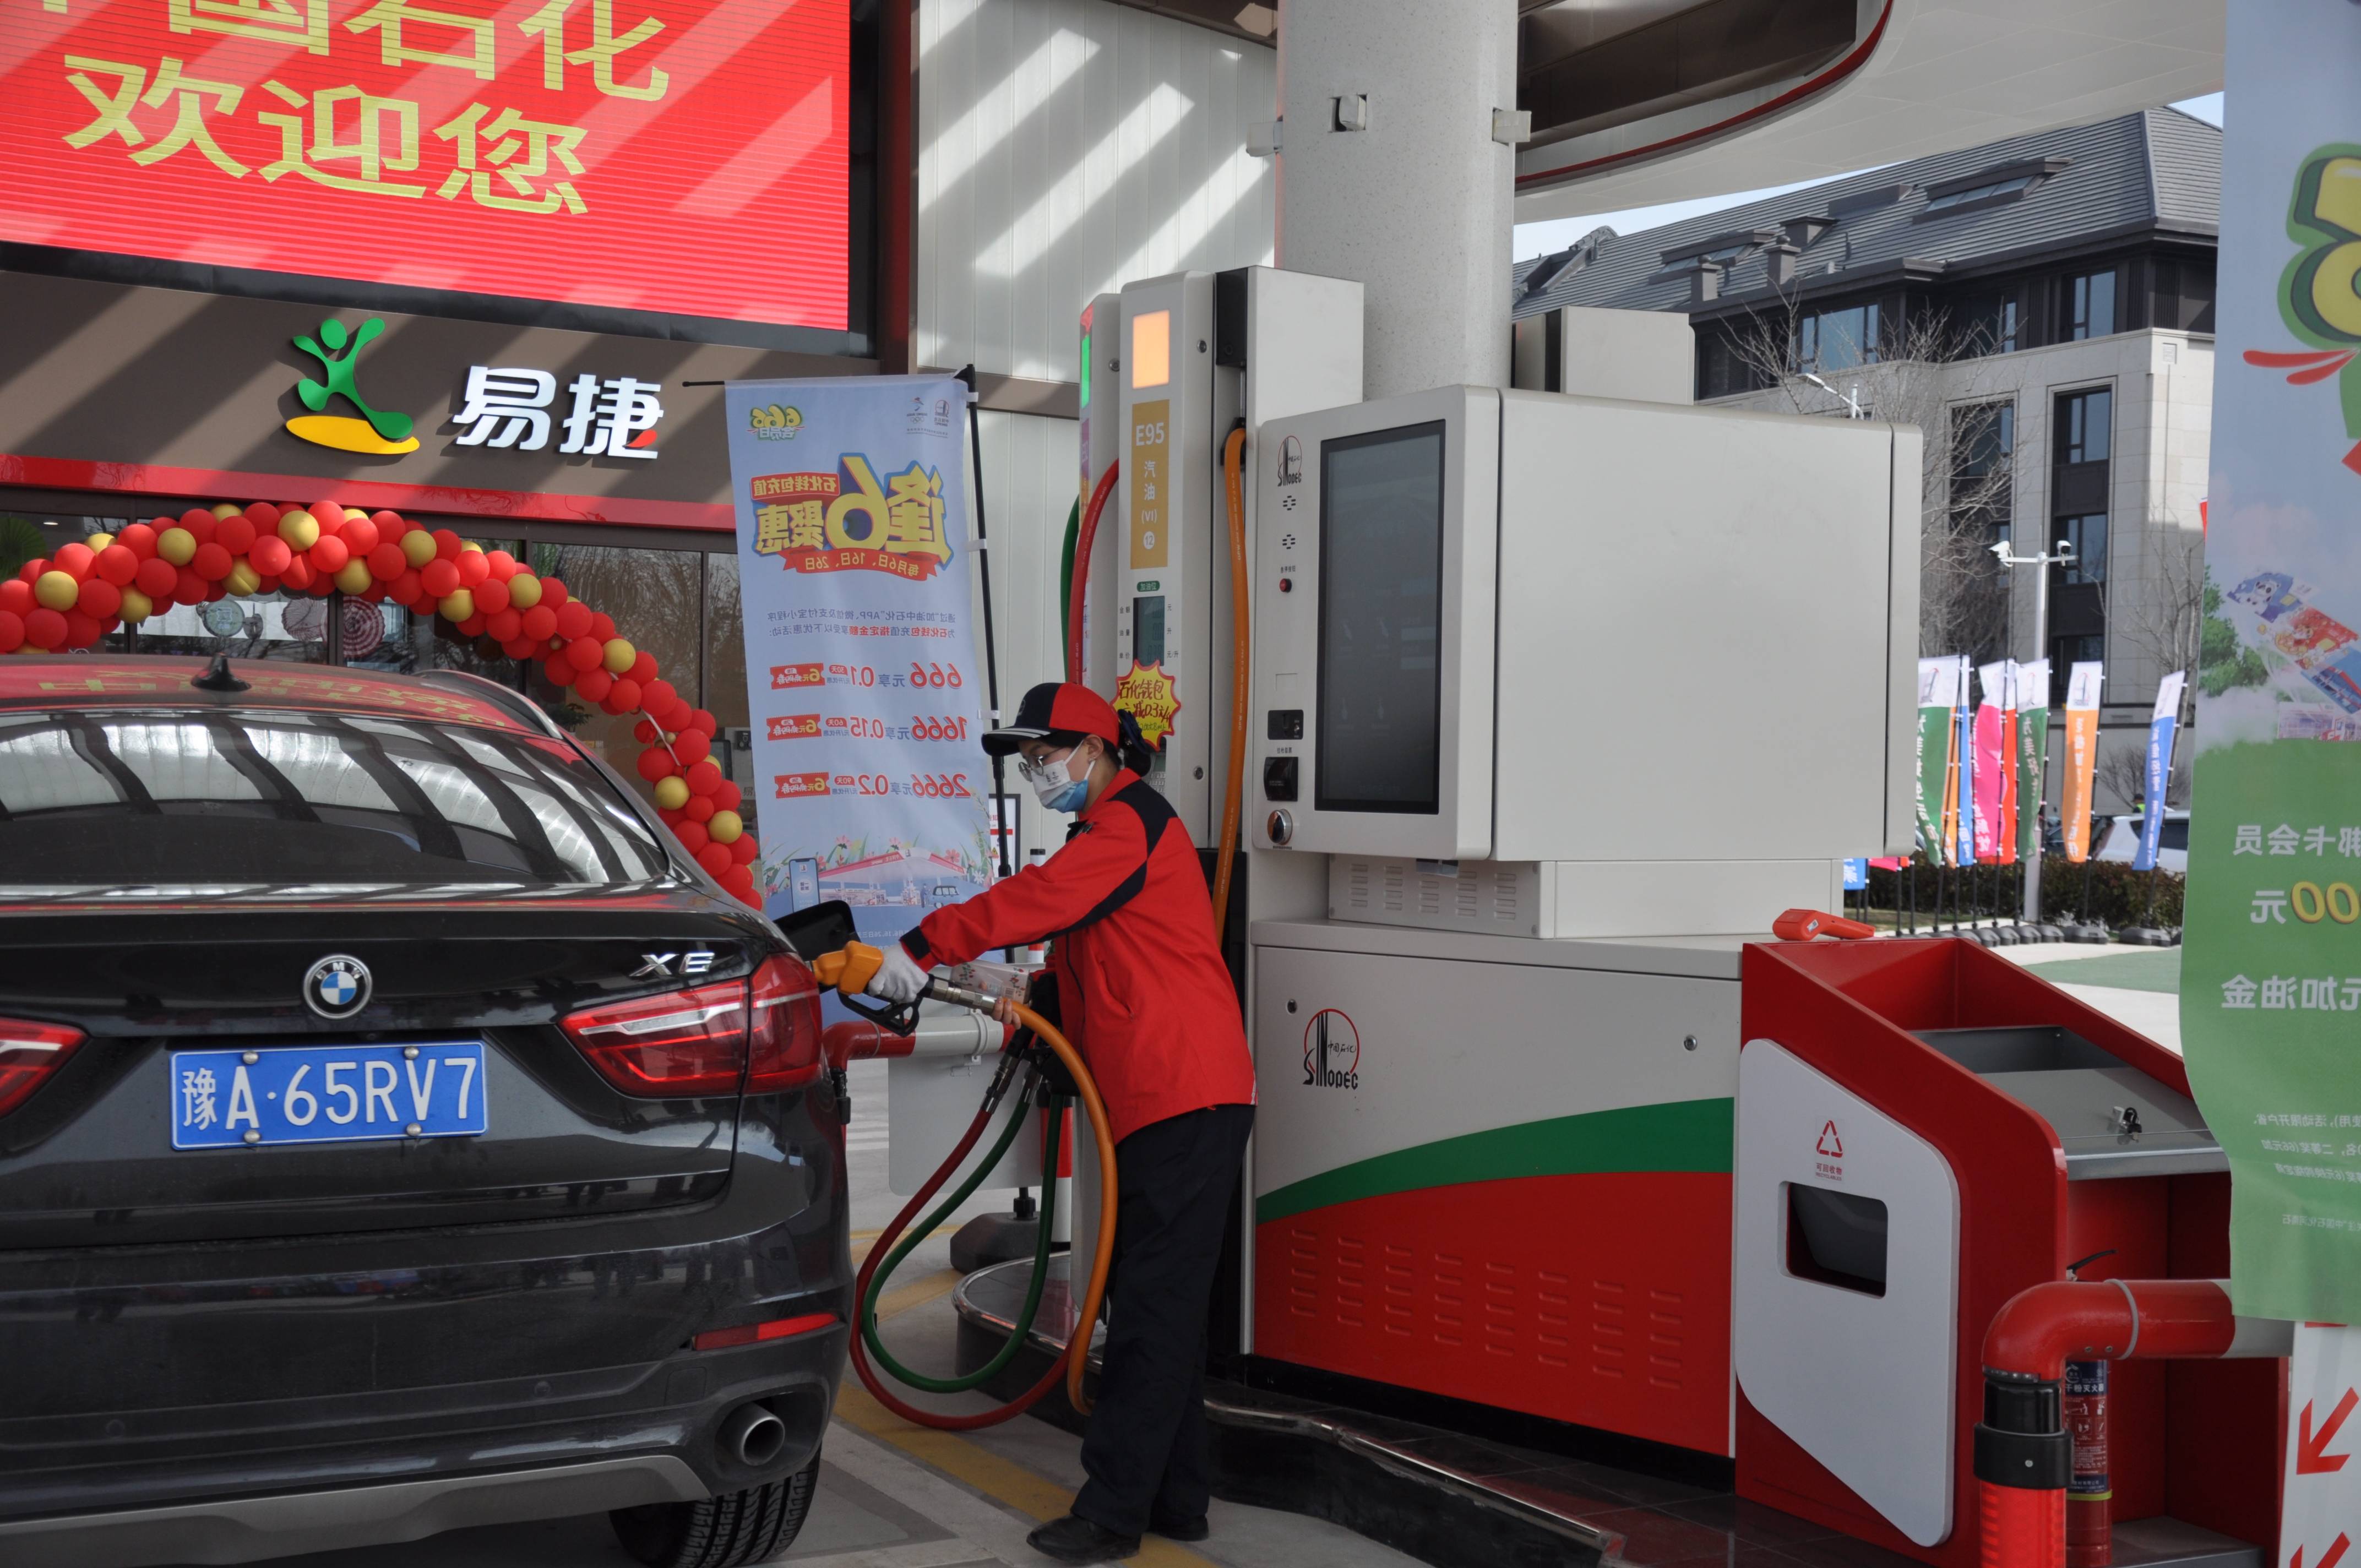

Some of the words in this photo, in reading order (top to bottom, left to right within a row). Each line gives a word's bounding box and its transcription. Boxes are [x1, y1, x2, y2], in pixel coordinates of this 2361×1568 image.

[62, 54, 589, 216] 欢迎您
[453, 366, 664, 460] 易捷
[1135, 422, 1165, 447] E95
[1143, 459, 1156, 501] 汽油
[1144, 535, 1154, 547] 12
[1140, 582, 1157, 592] 加油位
[1119, 679, 1164, 700] 石化钱包
[315, 961, 362, 981] BMW
[182, 1057, 477, 1131] 豫A·65RV7
[1816, 1162, 1842, 1175] 可回收物
[2065, 1382, 2104, 1393] 干粉灭火器
